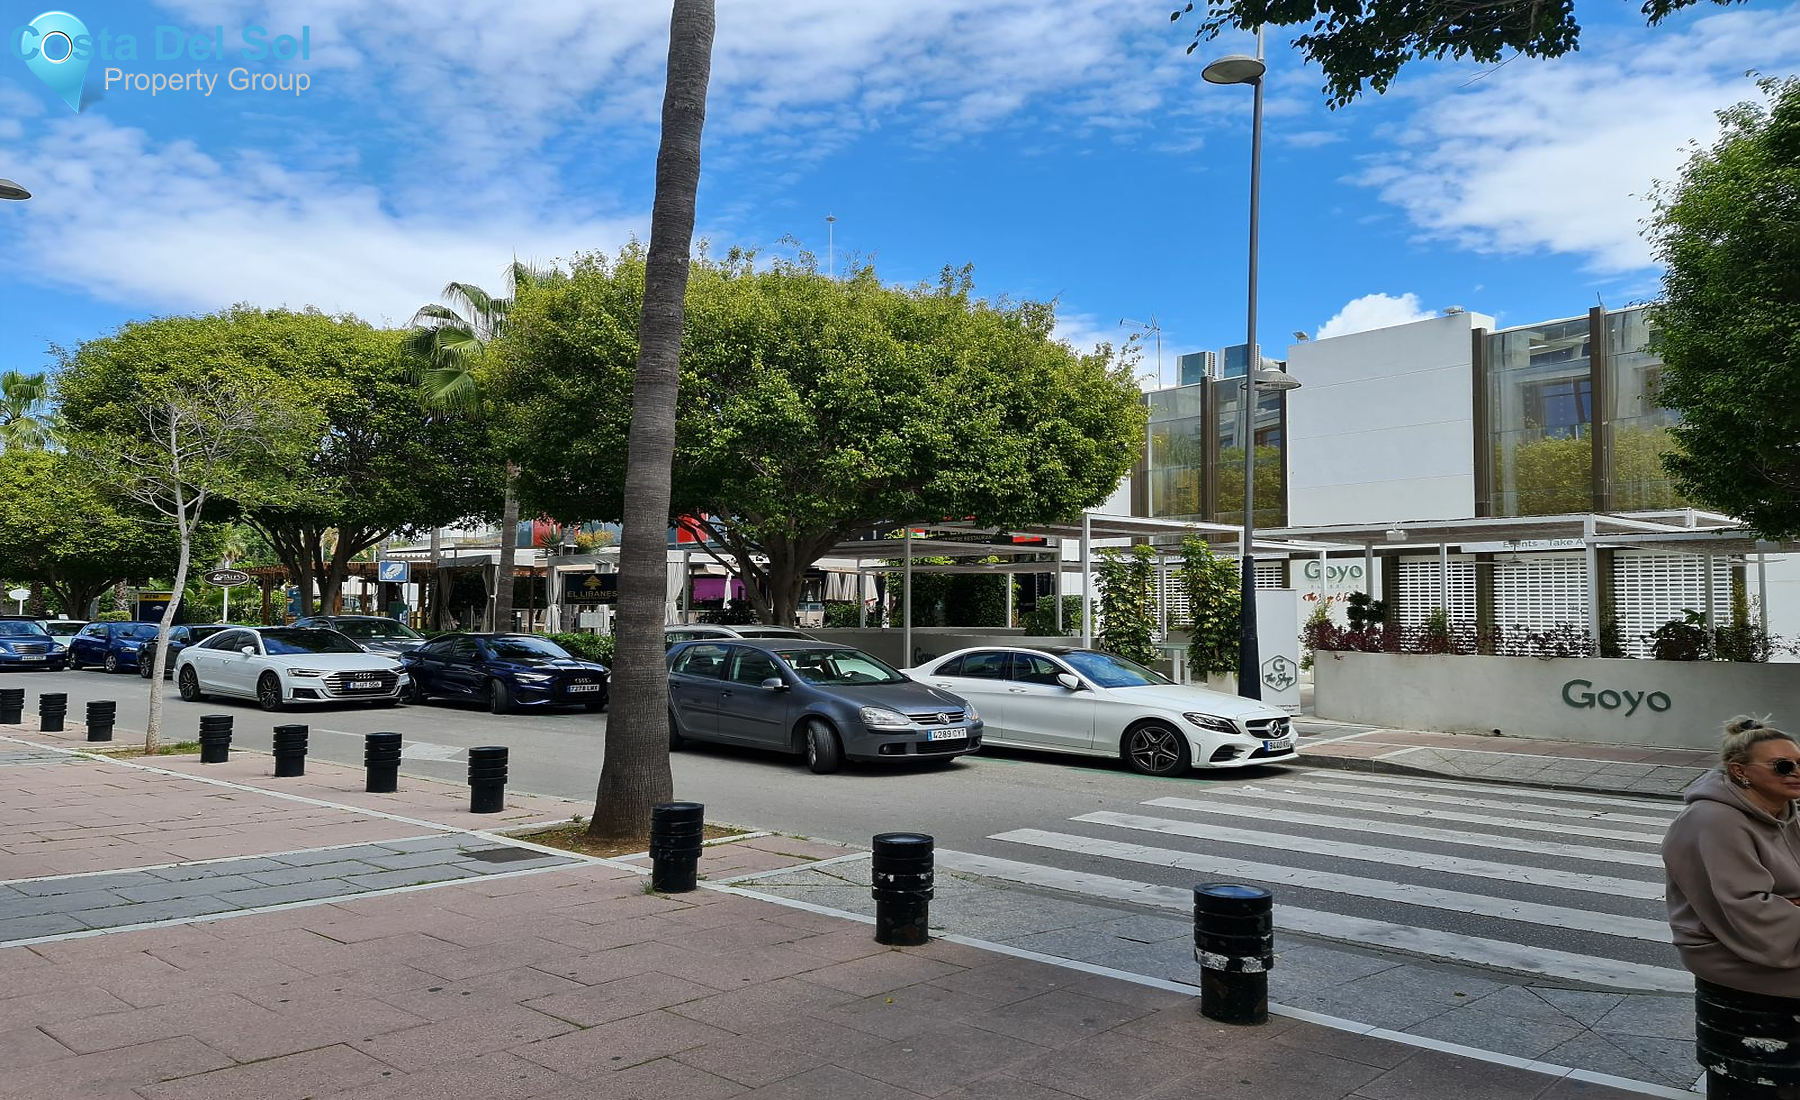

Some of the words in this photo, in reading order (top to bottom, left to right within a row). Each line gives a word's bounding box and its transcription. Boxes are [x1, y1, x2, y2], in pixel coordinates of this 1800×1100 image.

[1548, 538, 1574, 547] Take
[1304, 561, 1363, 583] Goyo
[580, 590, 619, 598] LIBANES
[1272, 659, 1285, 672] G
[1562, 679, 1671, 717] Goyo
[934, 730, 951, 739] 4289
